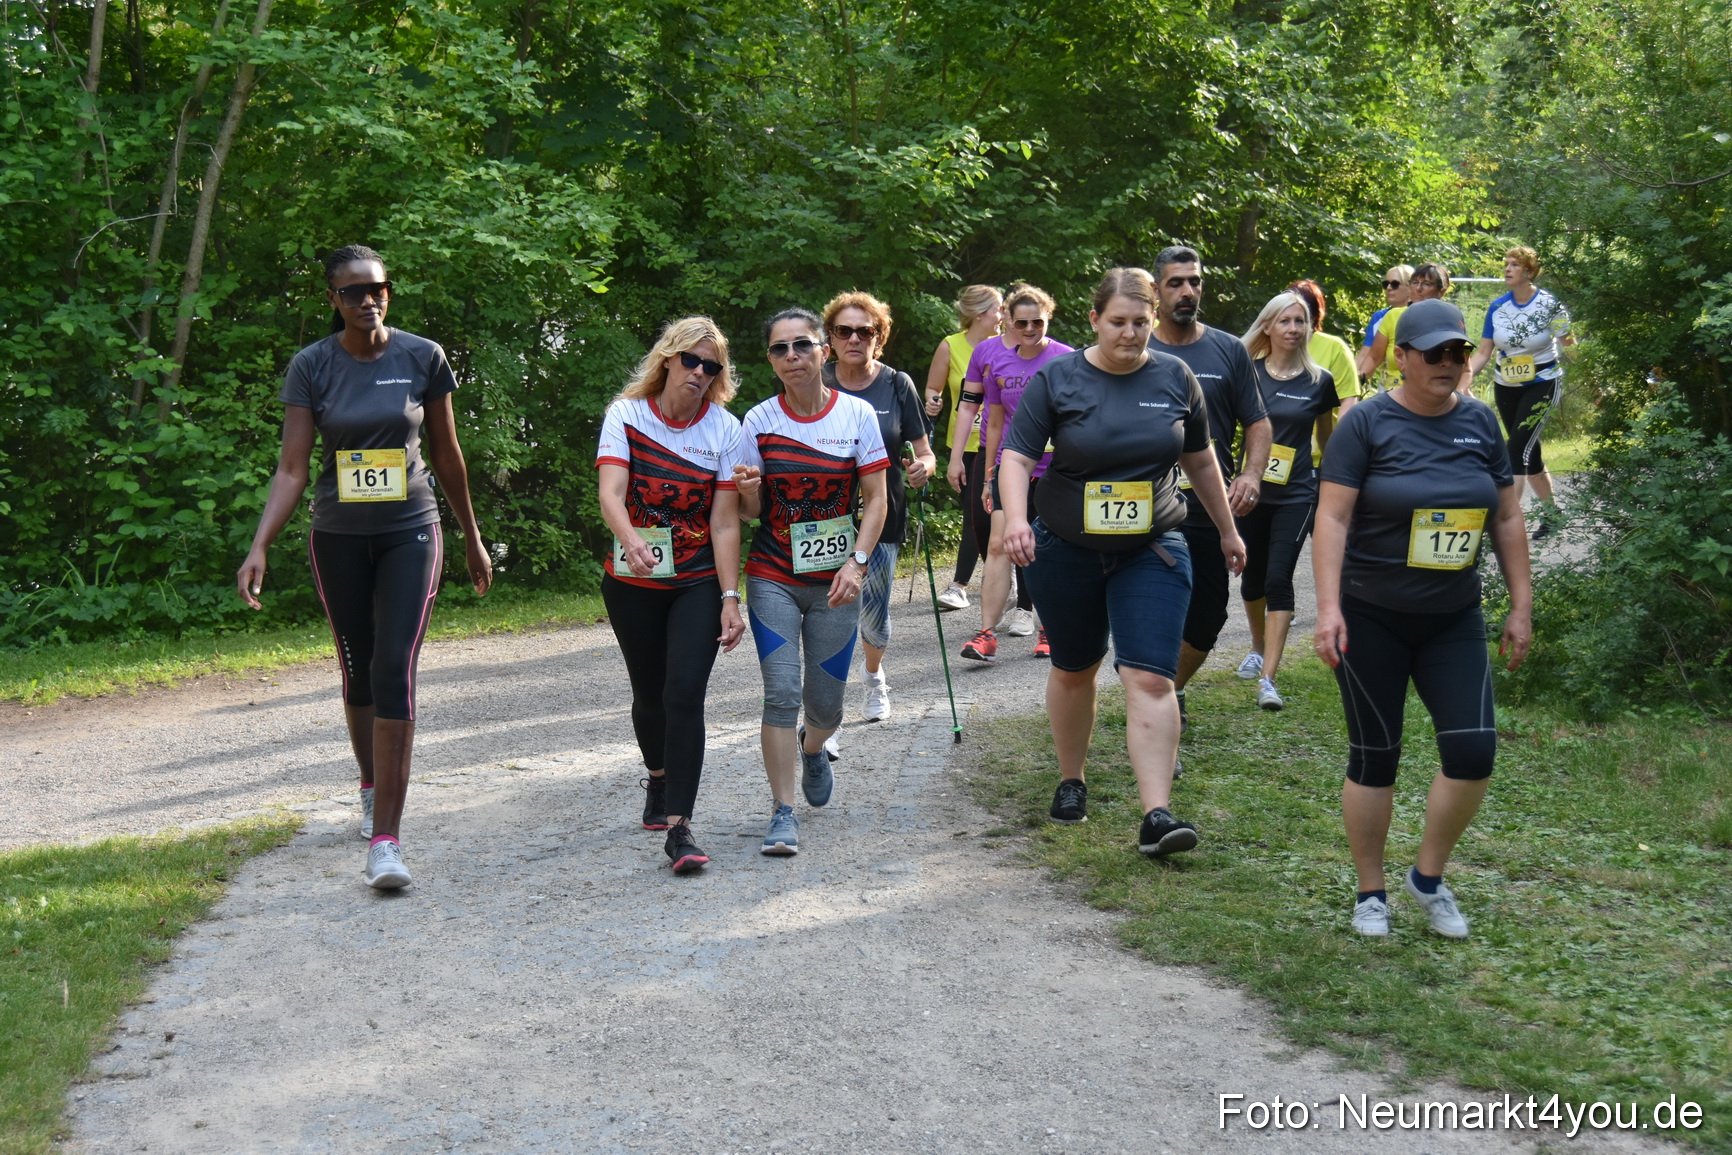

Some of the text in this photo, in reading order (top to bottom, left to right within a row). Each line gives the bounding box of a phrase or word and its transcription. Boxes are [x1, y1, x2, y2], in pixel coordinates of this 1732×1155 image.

[1505, 364, 1529, 376] 1102
[352, 468, 388, 488] 161
[1100, 501, 1138, 520] 173
[800, 534, 848, 559] 2259
[1430, 531, 1471, 553] 172
